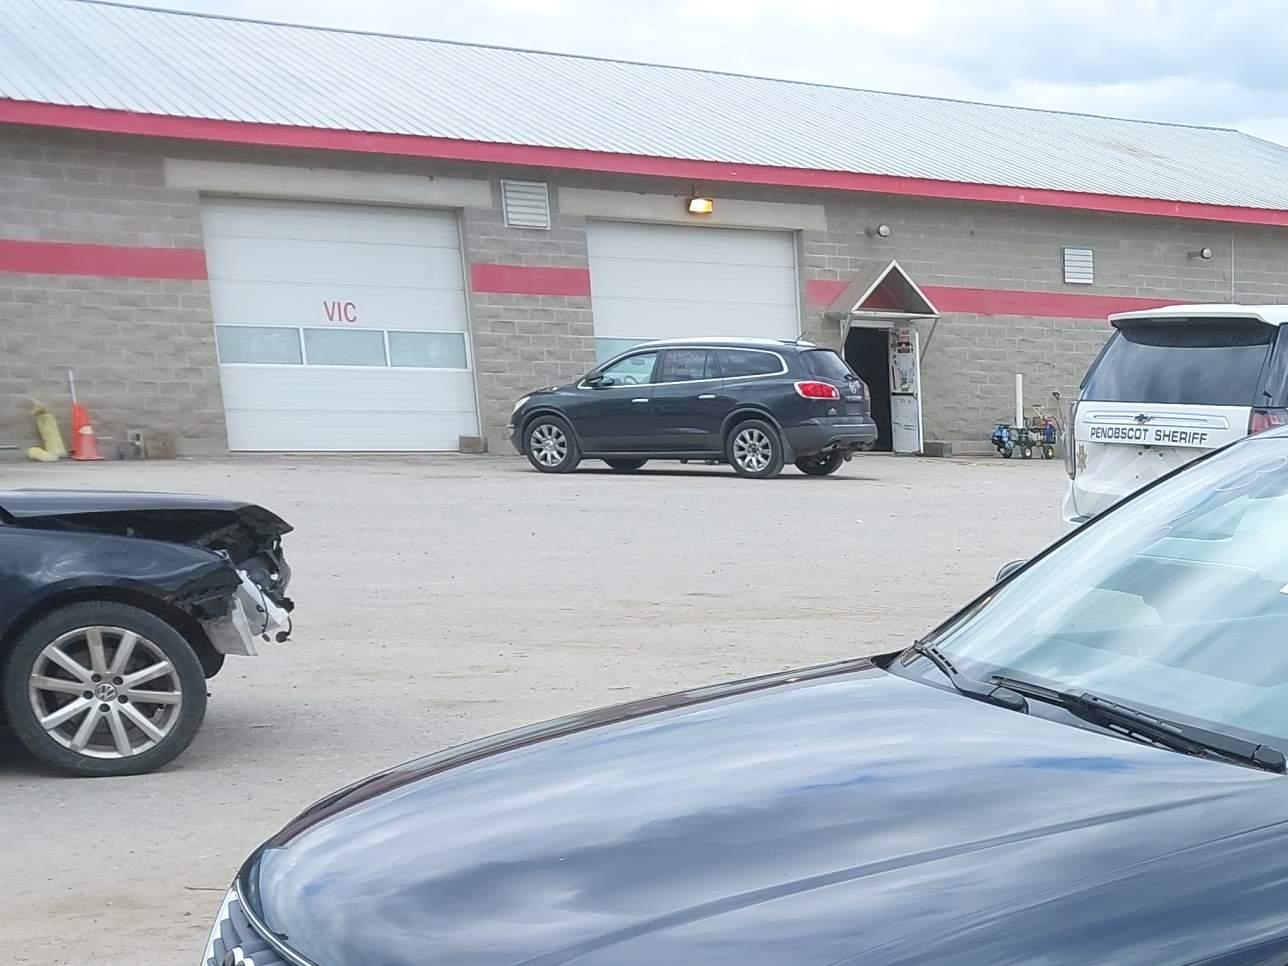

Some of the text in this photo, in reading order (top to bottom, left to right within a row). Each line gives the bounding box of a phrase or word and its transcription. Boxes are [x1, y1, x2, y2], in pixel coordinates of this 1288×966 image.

[322, 300, 358, 323] VIC
[1089, 426, 1209, 446] PENOBSCOT SHERIFF
